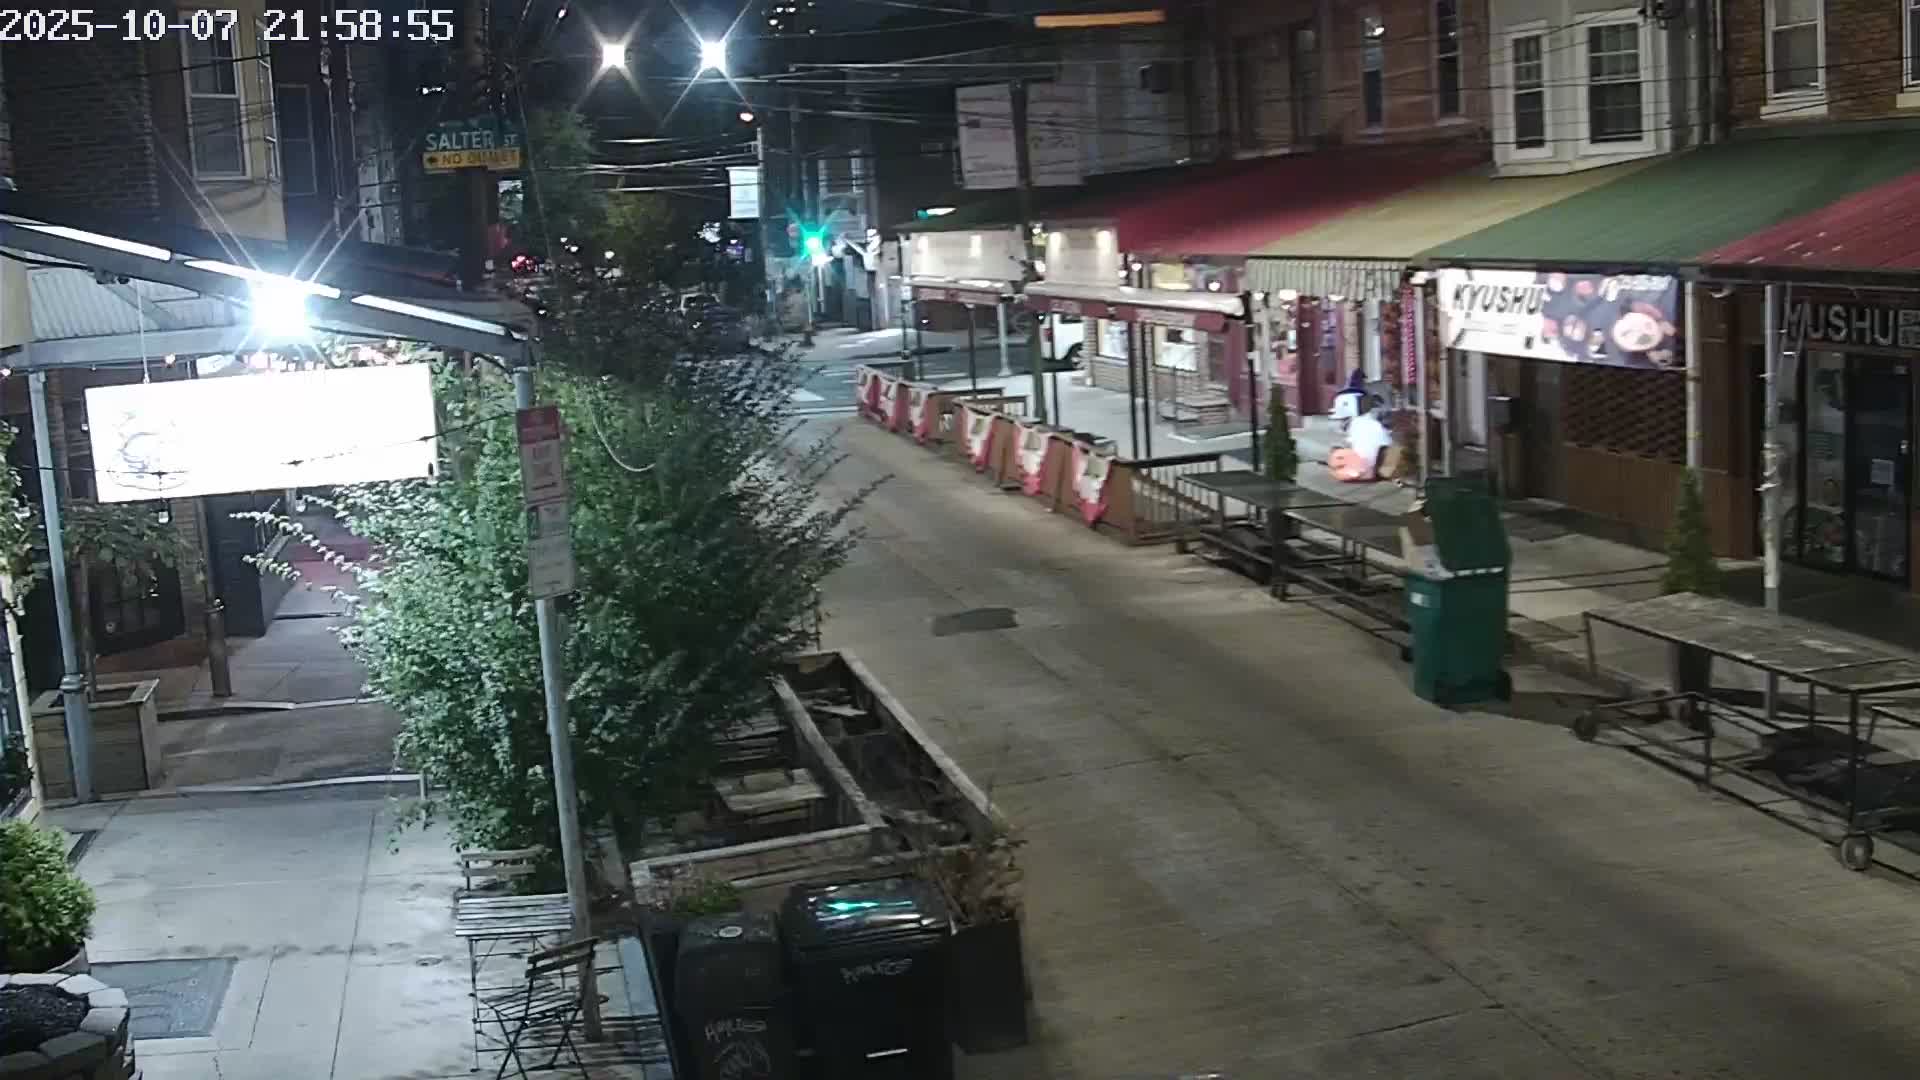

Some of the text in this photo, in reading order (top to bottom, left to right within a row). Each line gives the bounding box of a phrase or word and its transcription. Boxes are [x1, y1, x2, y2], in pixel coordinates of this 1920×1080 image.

[425, 130, 496, 151] SALTER
[441, 153, 462, 165] NO
[1453, 283, 1544, 315] KYUSHU
[1784, 303, 1895, 345] YUSHU
